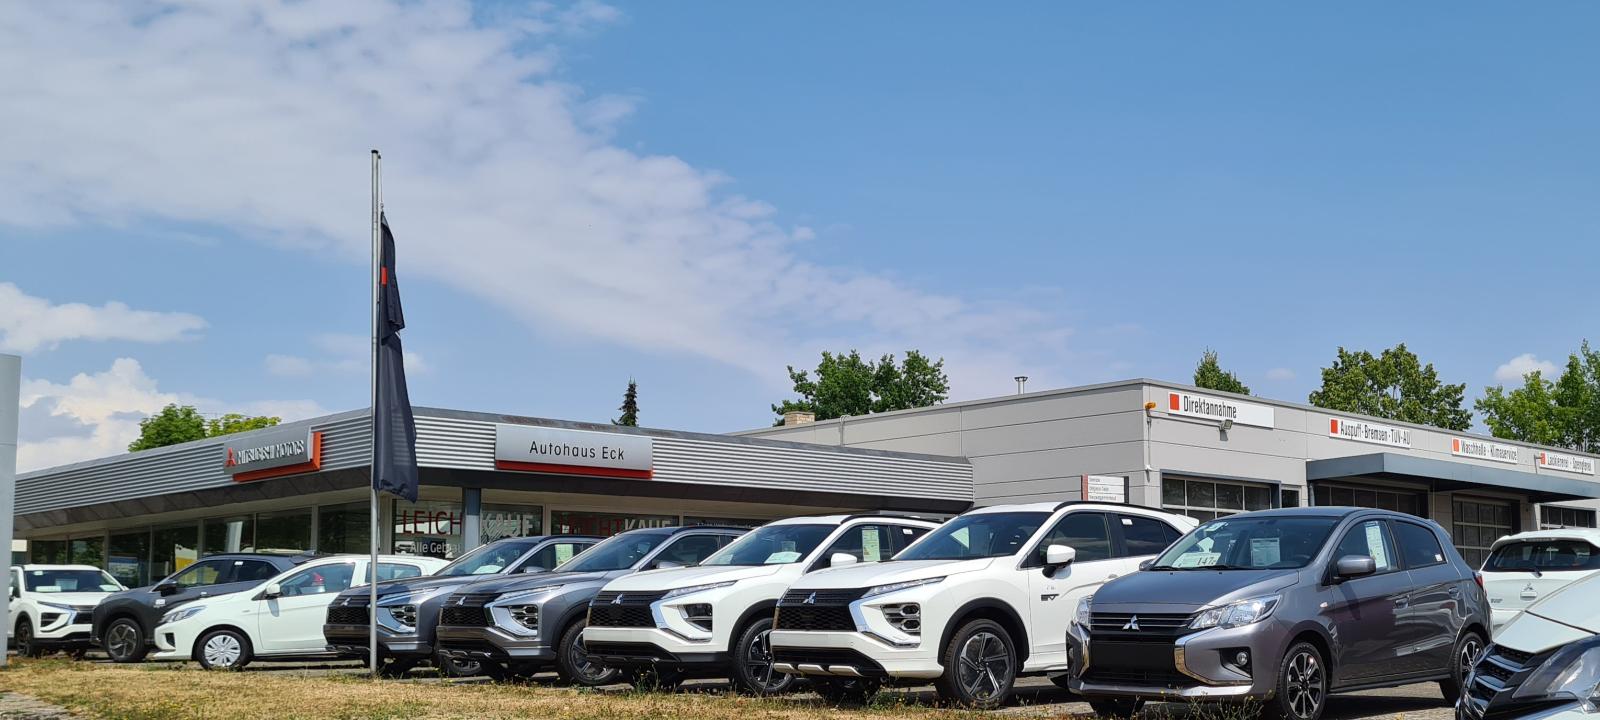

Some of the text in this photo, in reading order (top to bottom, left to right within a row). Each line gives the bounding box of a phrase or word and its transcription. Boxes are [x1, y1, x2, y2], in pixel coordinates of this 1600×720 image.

[1183, 395, 1237, 419] Direktannahme
[237, 439, 304, 465] MITSUBISHI MOTORS
[529, 440, 625, 461] Autohaus Eck
[402, 509, 463, 536] LEICH
[410, 542, 429, 553] Alle
